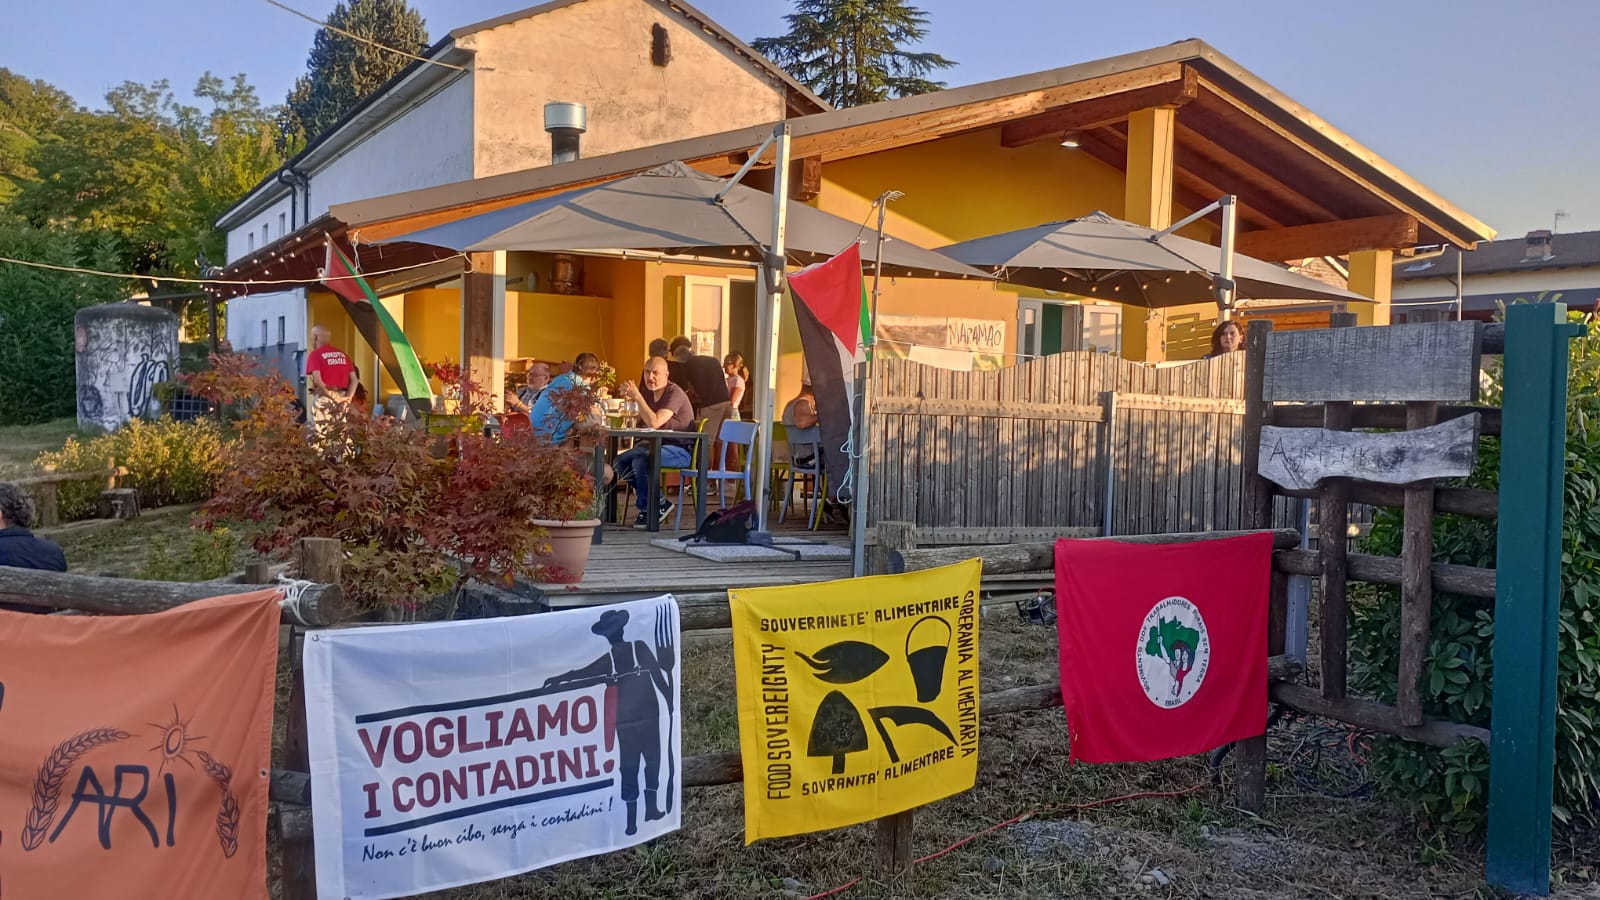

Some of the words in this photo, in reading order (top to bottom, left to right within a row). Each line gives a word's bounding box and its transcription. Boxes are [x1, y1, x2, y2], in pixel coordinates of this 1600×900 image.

[874, 596, 960, 623] ALIMENTAIRE
[957, 590, 975, 665] SOBERANIA
[1196, 659, 1208, 683] TERRA
[761, 643, 792, 760] SOVEREIGNTY
[957, 669, 977, 758] ALIMENTARIA
[357, 695, 598, 768] VOGLIAMO
[767, 763, 792, 800] FOOD
[884, 745, 955, 781] ALIMENTARE
[49, 764, 177, 850] ARI
[363, 782, 382, 819] I
[362, 844, 395, 862] Non
[399, 838, 417, 856] c'è
[421, 834, 453, 852] buon
[456, 824, 486, 843] cibo,
[489, 821, 527, 839] senza
[530, 815, 538, 828] i
